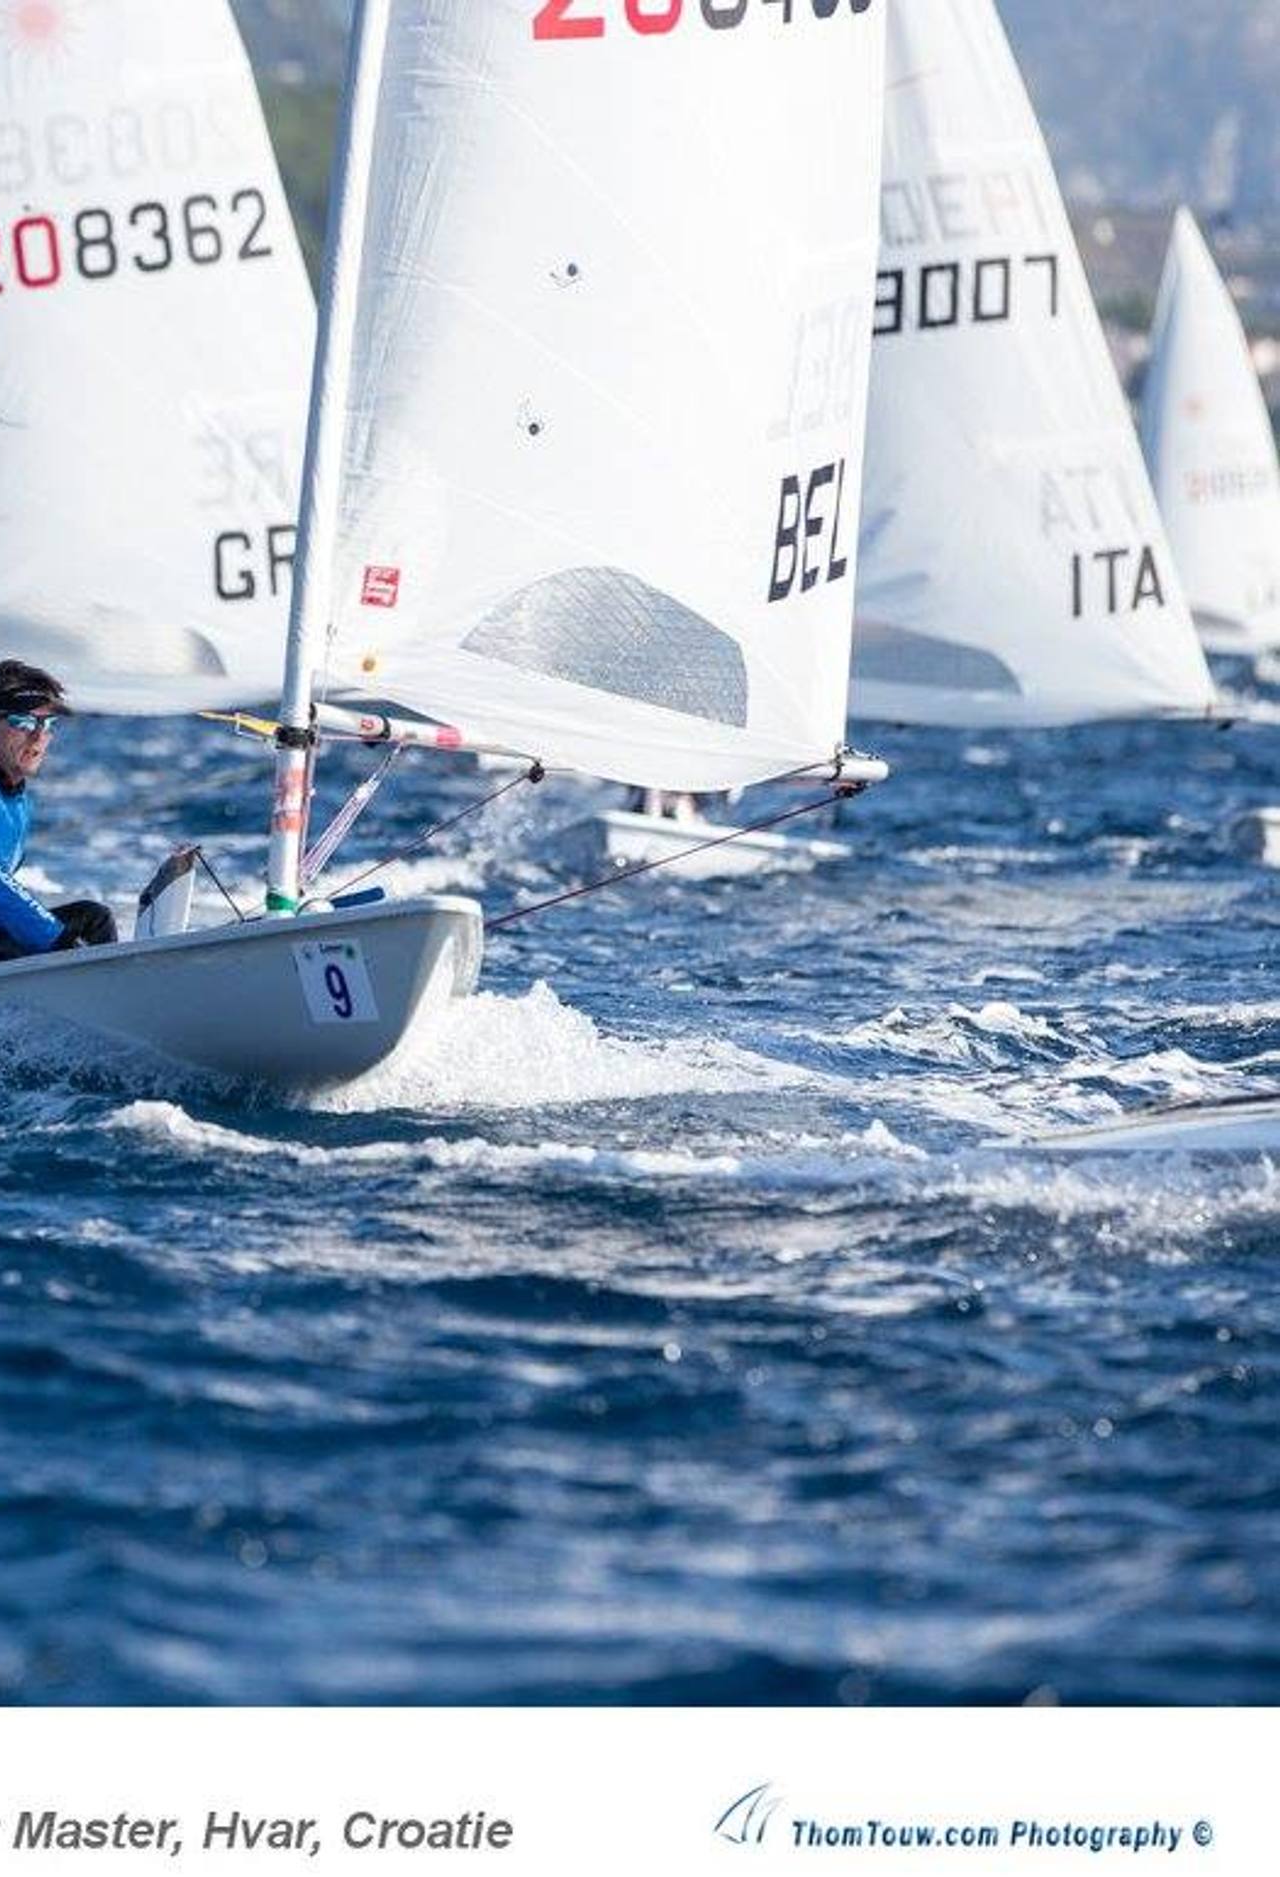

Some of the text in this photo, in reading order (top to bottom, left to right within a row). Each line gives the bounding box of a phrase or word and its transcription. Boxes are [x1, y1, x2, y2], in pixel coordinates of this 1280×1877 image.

[768, 458, 847, 603] BEL
[1072, 546, 1164, 617] ITA
[325, 963, 353, 1018] 9
